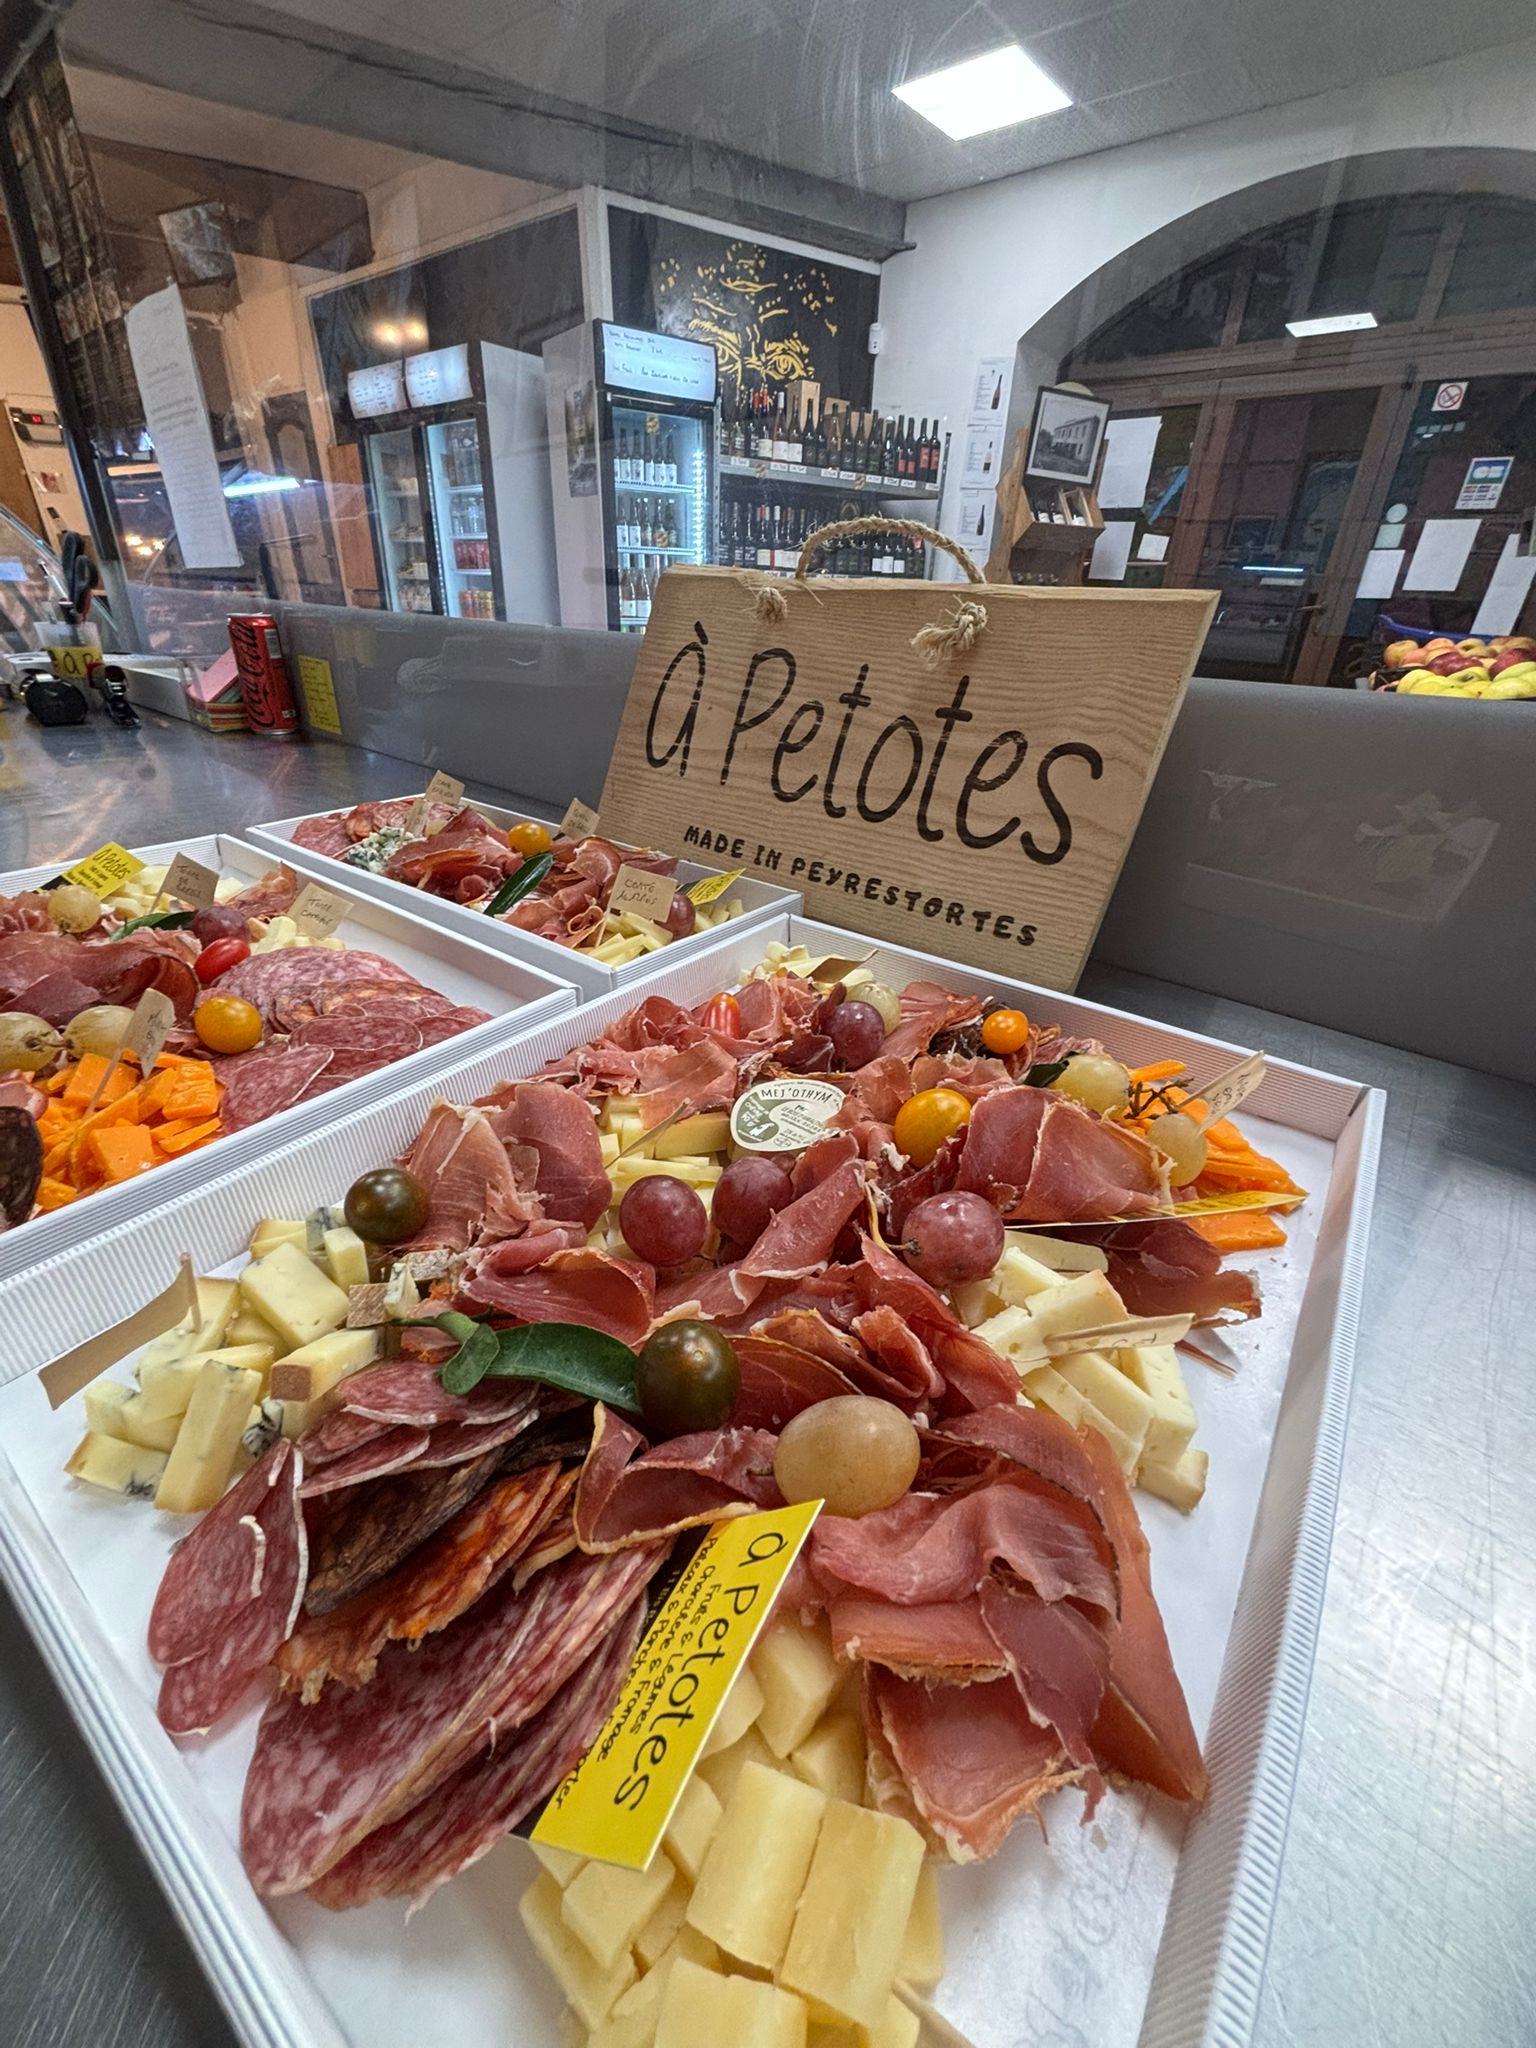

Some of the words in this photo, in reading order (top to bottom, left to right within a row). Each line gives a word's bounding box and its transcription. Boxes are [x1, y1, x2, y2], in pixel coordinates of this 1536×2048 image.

[720, 647, 1103, 866] Petotes
[684, 826, 744, 859] MADE
[753, 844, 783, 871] IN
[790, 856, 1038, 947] PEYRESTORTES
[761, 1087, 833, 1104] MEJ'OTHYM
[676, 1536, 719, 1595] Plateaux
[667, 1599, 680, 1615] &
[680, 1630, 694, 1648] &
[623, 1618, 669, 1689] Planches
[649, 1656, 662, 1674] &
[596, 1679, 651, 1763] Fromage
[613, 1583, 760, 1812] Petotes
